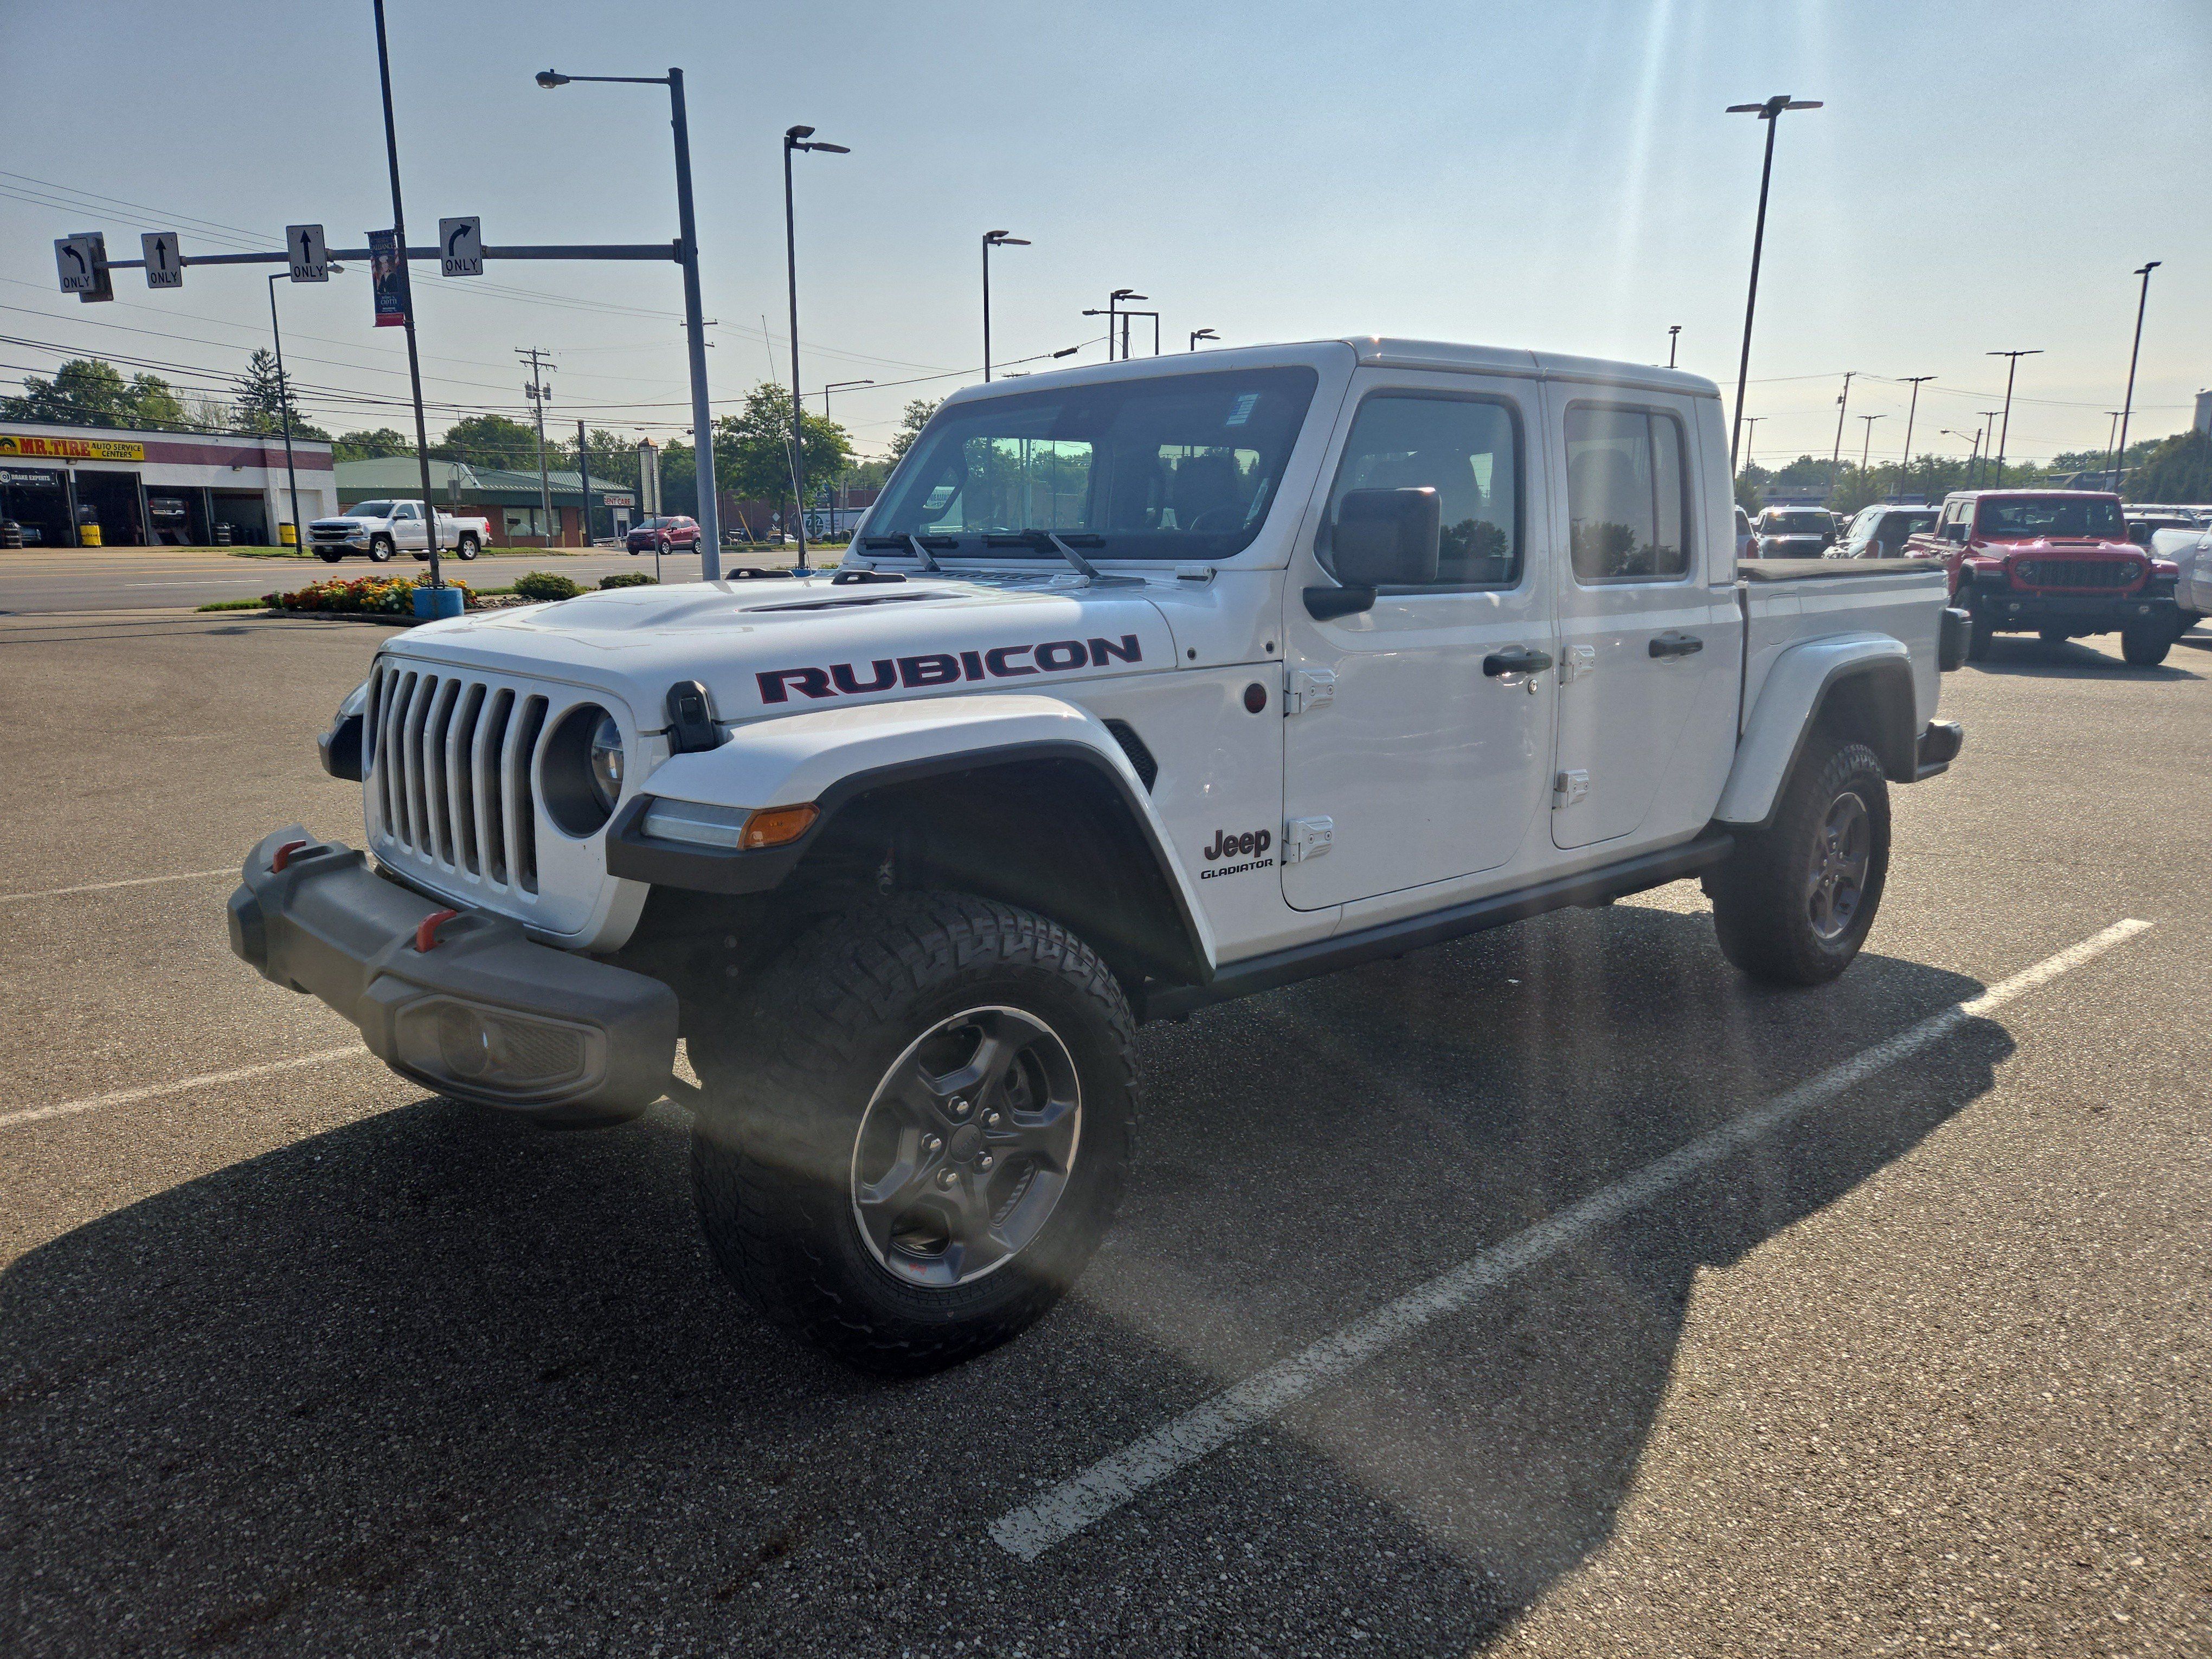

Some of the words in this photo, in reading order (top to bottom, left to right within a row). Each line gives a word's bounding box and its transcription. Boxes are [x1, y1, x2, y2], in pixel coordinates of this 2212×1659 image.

[446, 258, 477, 271] ONLY
[294, 266, 323, 277] ONLY
[63, 276, 89, 288] ONLY
[150, 272, 177, 284] ONLY
[113, 443, 141, 452] SERVICE
[755, 634, 1143, 704] RUBICON
[1204, 829, 1271, 860] Jeep
[1201, 858, 1274, 879] GLADIATOR
